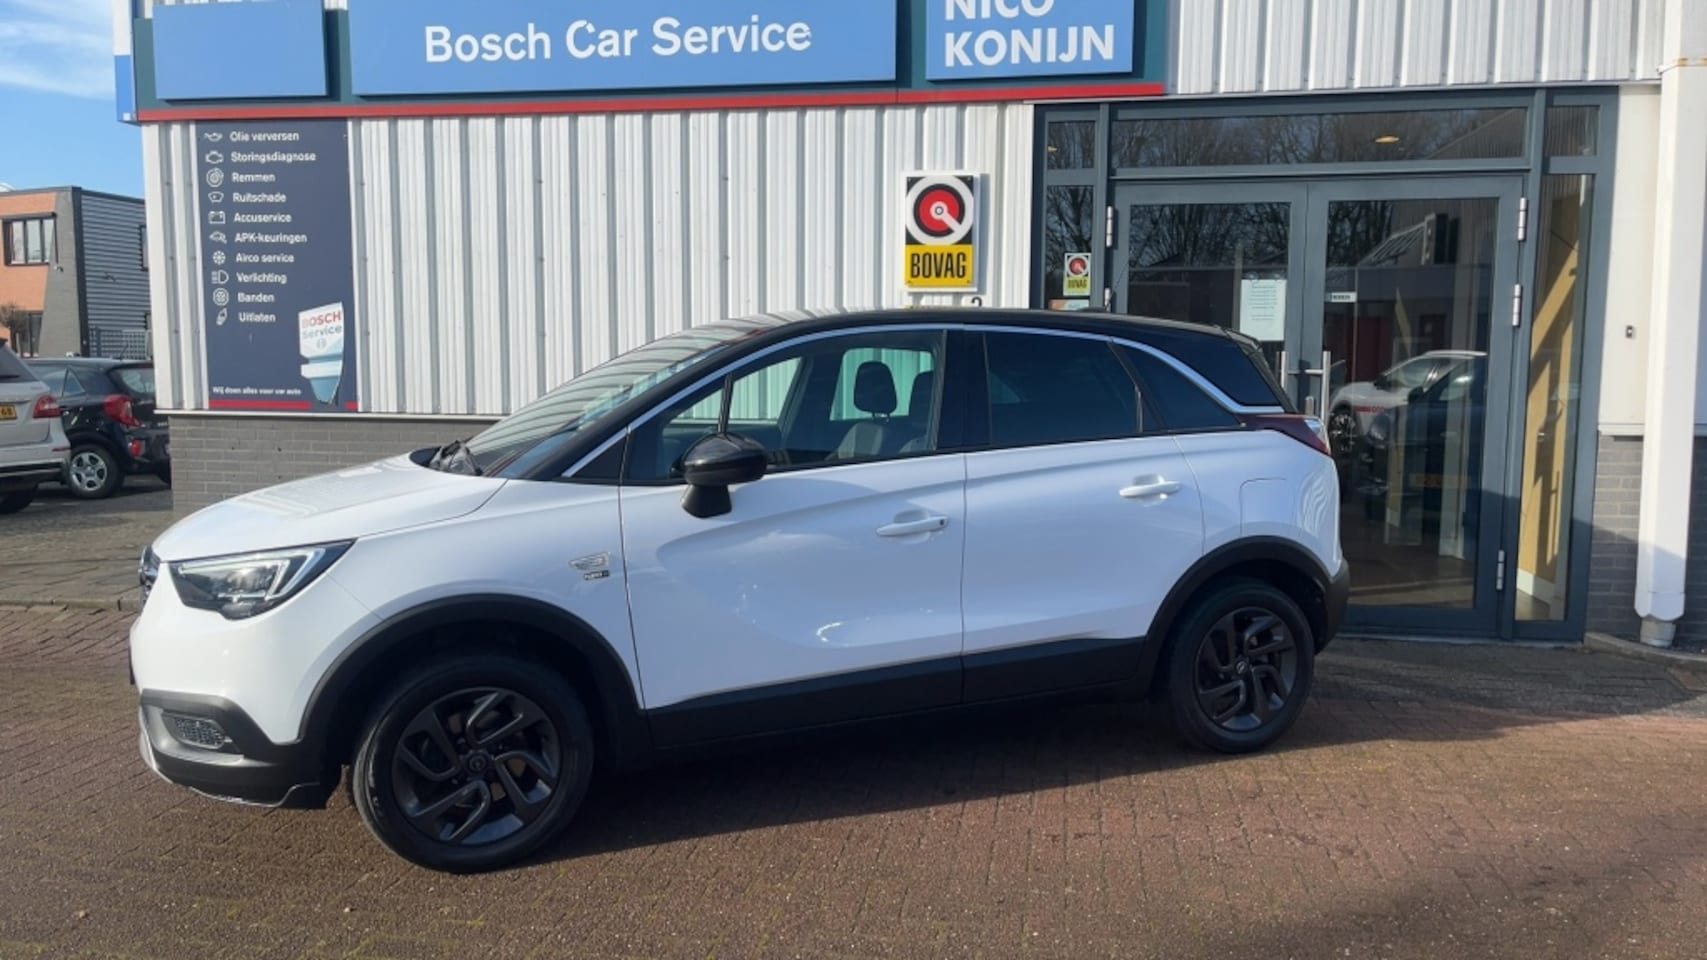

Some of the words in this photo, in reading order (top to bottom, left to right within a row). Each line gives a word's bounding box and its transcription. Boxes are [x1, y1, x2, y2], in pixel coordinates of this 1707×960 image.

[425, 23, 551, 63] Bosch
[566, 19, 638, 59] Car
[652, 14, 811, 55] Service
[945, 24, 1114, 67] KONIJN
[229, 131, 250, 142] Olie
[252, 131, 299, 142] verversen
[231, 151, 316, 164] Storingsdiagnose
[232, 172, 275, 182] Remmen
[233, 192, 286, 202] Ruitschade
[234, 212, 292, 223] Accuservice
[235, 232, 307, 244] APK-keuringen
[236, 252, 259, 263] Airco
[261, 252, 294, 263] service
[910, 252, 966, 279] BOVAG
[236, 272, 287, 284] Verlichting
[1067, 279, 1088, 289] BOVAG
[238, 292, 275, 302] Banden
[239, 312, 276, 322] Uitlaten
[302, 310, 341, 328] BOSCH
[302, 325, 342, 339] Service
